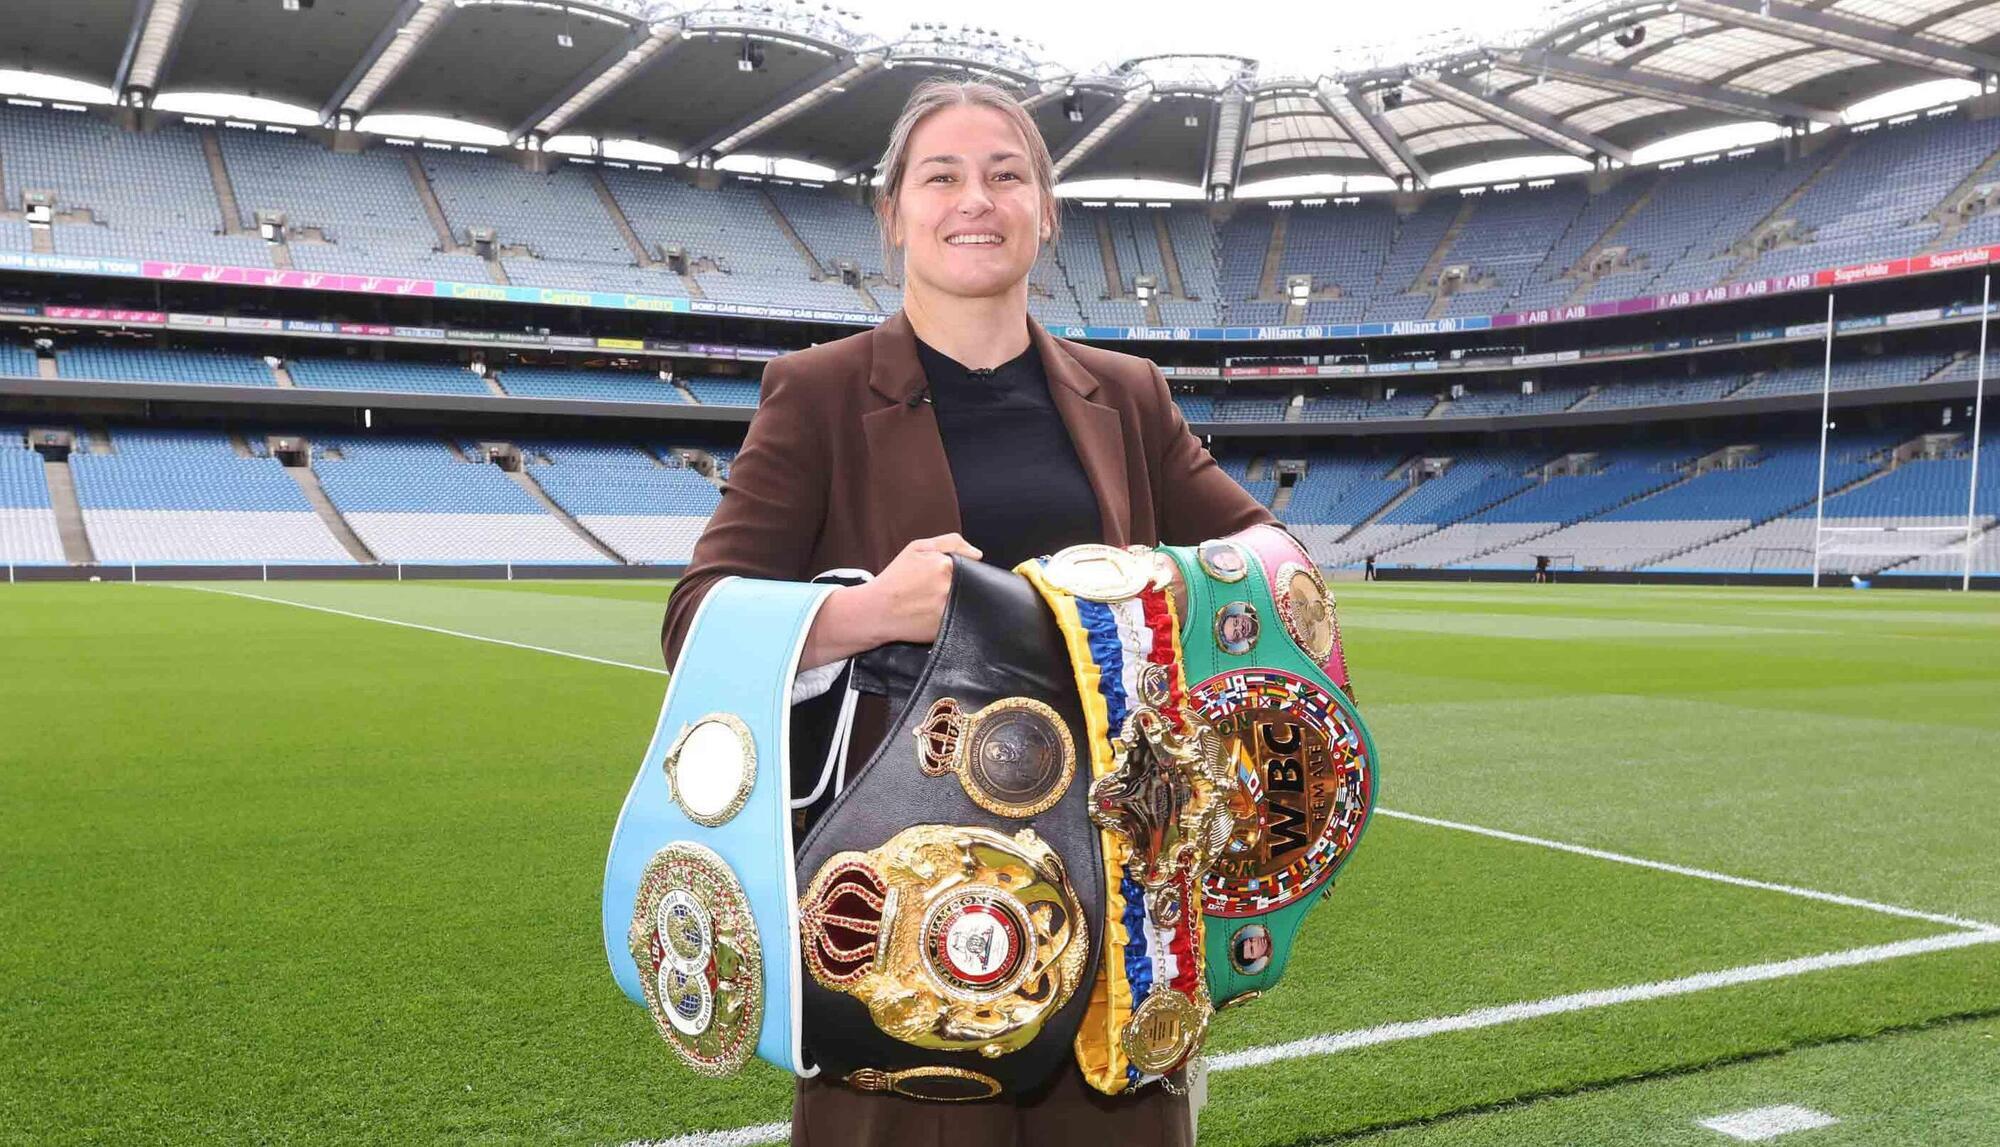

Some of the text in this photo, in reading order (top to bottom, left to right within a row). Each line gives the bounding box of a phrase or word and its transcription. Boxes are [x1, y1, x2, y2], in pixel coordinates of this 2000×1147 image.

[1929, 249, 1989, 268] SuperValu
[1834, 264, 1888, 282] SuperValu
[1745, 279, 1766, 295] AIB
[1787, 274, 1810, 290] AIB
[1669, 293, 1690, 307] AIB
[1705, 287, 1727, 301] AIB
[1528, 311, 1548, 323] AIB
[1565, 306, 1586, 319] AIB
[288, 321, 320, 332] Allianz
[1127, 327, 1171, 339] Allianz
[1258, 327, 1303, 339] Allianz
[1391, 322, 1436, 334] Allianz
[1262, 722, 1306, 857] WBC
[1309, 744, 1327, 822] FEMALE
[652, 936, 661, 963] IBF
